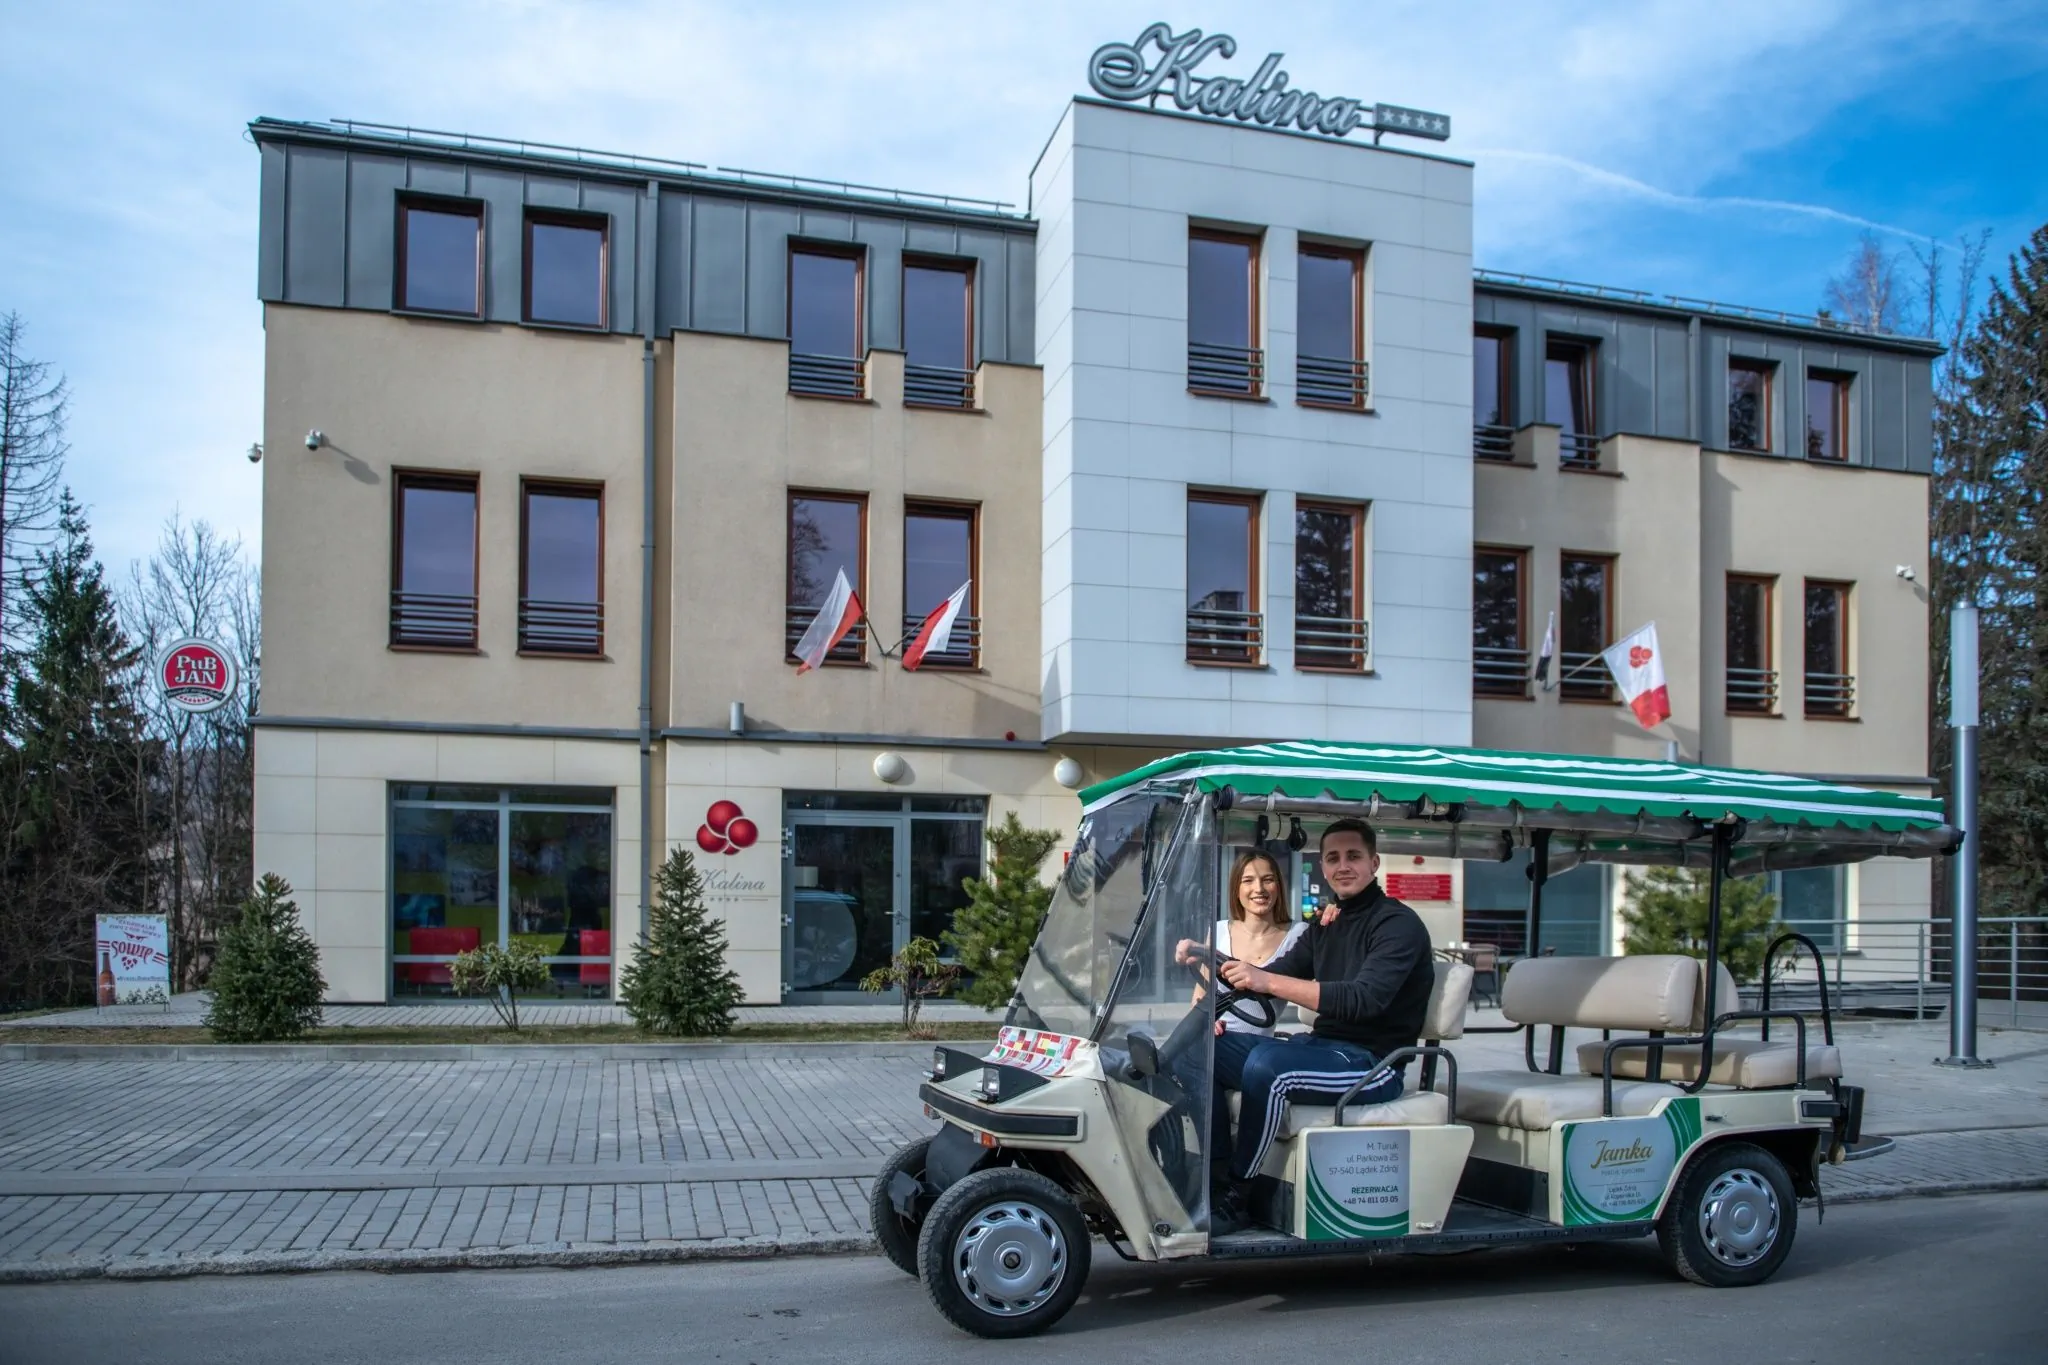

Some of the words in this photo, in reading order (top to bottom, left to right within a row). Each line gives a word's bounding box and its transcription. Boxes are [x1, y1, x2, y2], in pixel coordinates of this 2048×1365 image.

[1088, 21, 1362, 137] Kalina
[174, 670, 217, 684] JAN
[700, 868, 766, 890] Kalina
[1356, 1153, 1389, 1163] Parkowa
[1590, 1137, 1654, 1169] Jamka
[1328, 1166, 1355, 1176] 57-540
[1351, 1185, 1399, 1194] REZERWACJA
[1343, 1197, 1357, 1205] +48
